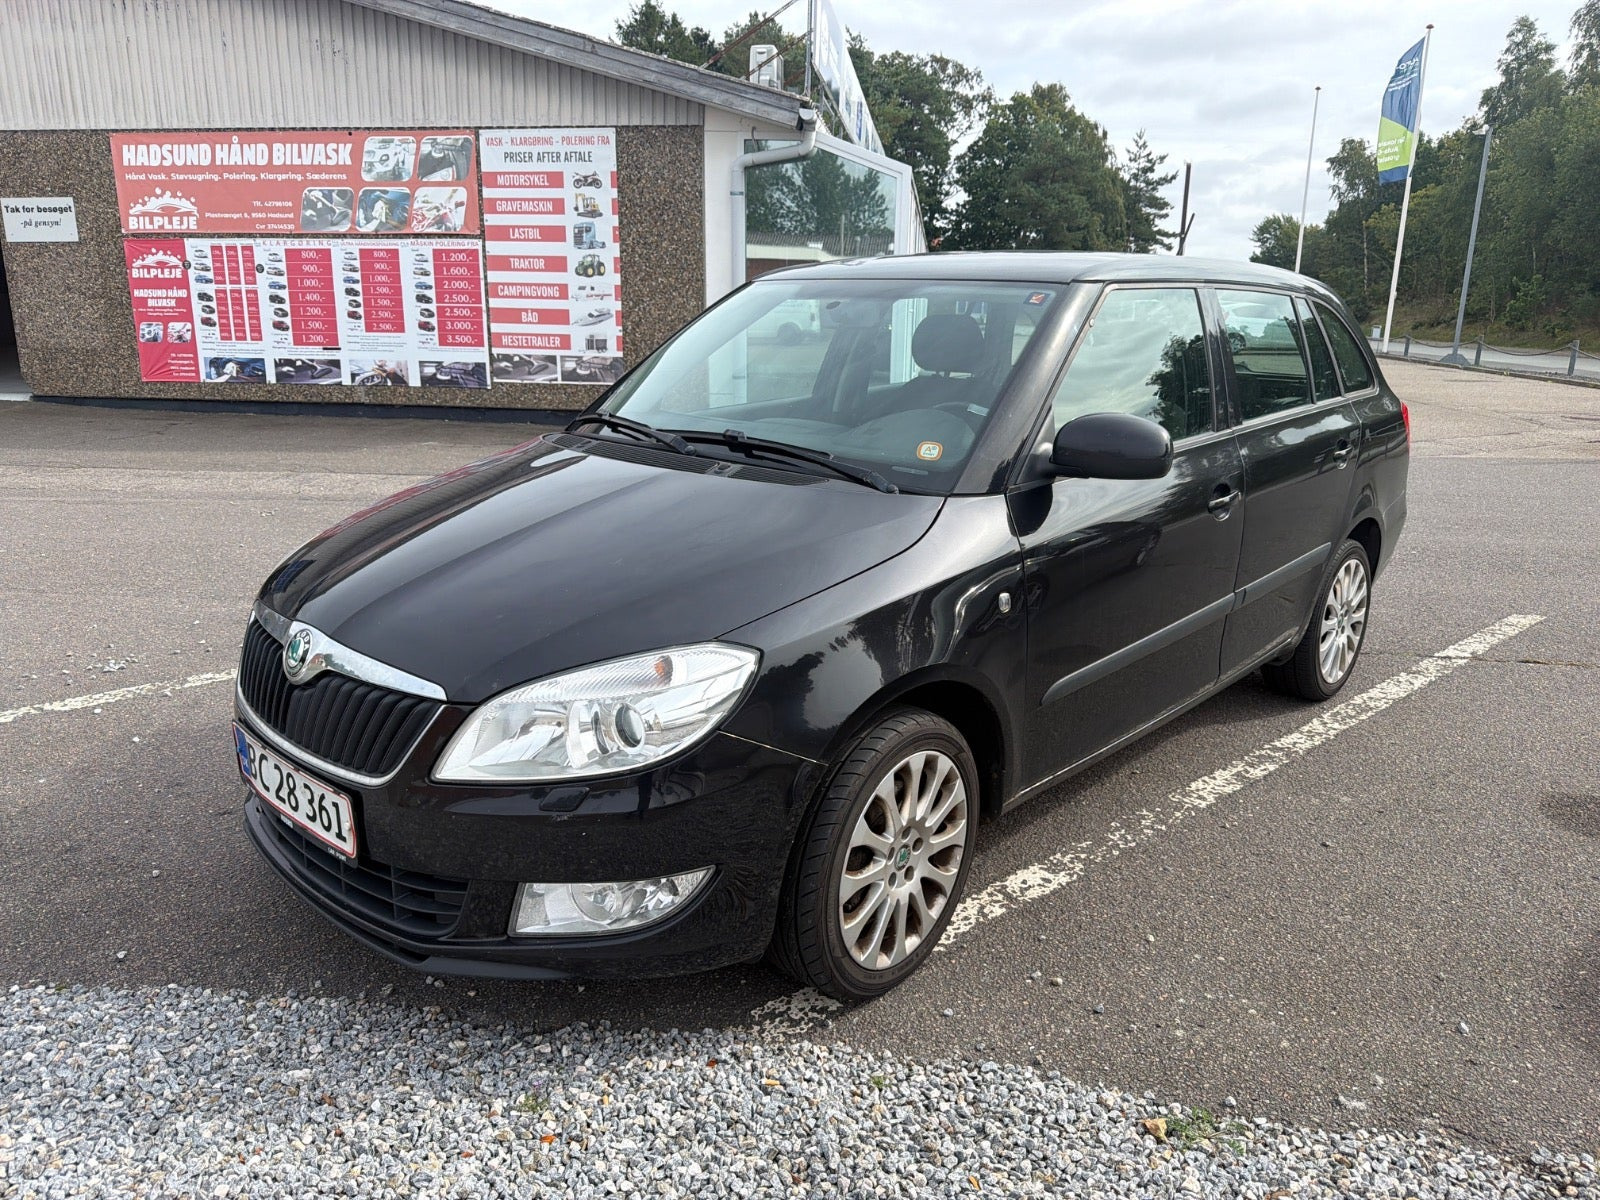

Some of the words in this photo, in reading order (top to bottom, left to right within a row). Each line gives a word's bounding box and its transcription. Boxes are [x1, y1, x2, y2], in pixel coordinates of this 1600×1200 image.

[485, 137, 503, 146] VASK
[510, 136, 554, 146] KLARGØRING
[561, 136, 595, 146] POLERING
[597, 136, 610, 145] FRA
[122, 144, 212, 167] HADSUND
[215, 135, 269, 166] HÅND
[272, 143, 352, 166] BILVASK
[504, 151, 533, 163] PRISER
[537, 151, 560, 163] AFTER
[564, 151, 592, 162] AFTALE
[497, 174, 549, 186] MOTORSYKEL
[37, 205, 72, 214] besøget
[496, 201, 552, 212] GRAVEMASKIN
[129, 216, 197, 230] BILPLEJE
[510, 228, 542, 239] LASTBIL
[442, 253, 473, 262] 1.200,-
[509, 258, 545, 269] TRAKTOR
[132, 268, 182, 278] BILPLEJE
[302, 265, 323, 273] 900,-
[443, 268, 474, 276] 1.600,-
[297, 279, 324, 287] 1.000,-
[443, 281, 474, 289] 2.000,-
[498, 285, 560, 297] CAMPINGVONG
[148, 298, 176, 306] BILVASK
[298, 293, 326, 302] 1.400,-
[444, 295, 476, 303] 2.500,-
[300, 307, 326, 316] 1.200,-
[445, 308, 476, 317] 2.500,-
[521, 310, 538, 323] BÅD
[301, 321, 328, 330] 1.500,-
[445, 322, 477, 330] 3.000,-
[302, 335, 329, 343] 1.200,-
[446, 335, 478, 343] 3.500,-
[502, 335, 560, 347] HESTETRAILER
[248, 742, 270, 792] BC
[274, 763, 299, 812] 28
[304, 782, 347, 843] 361
